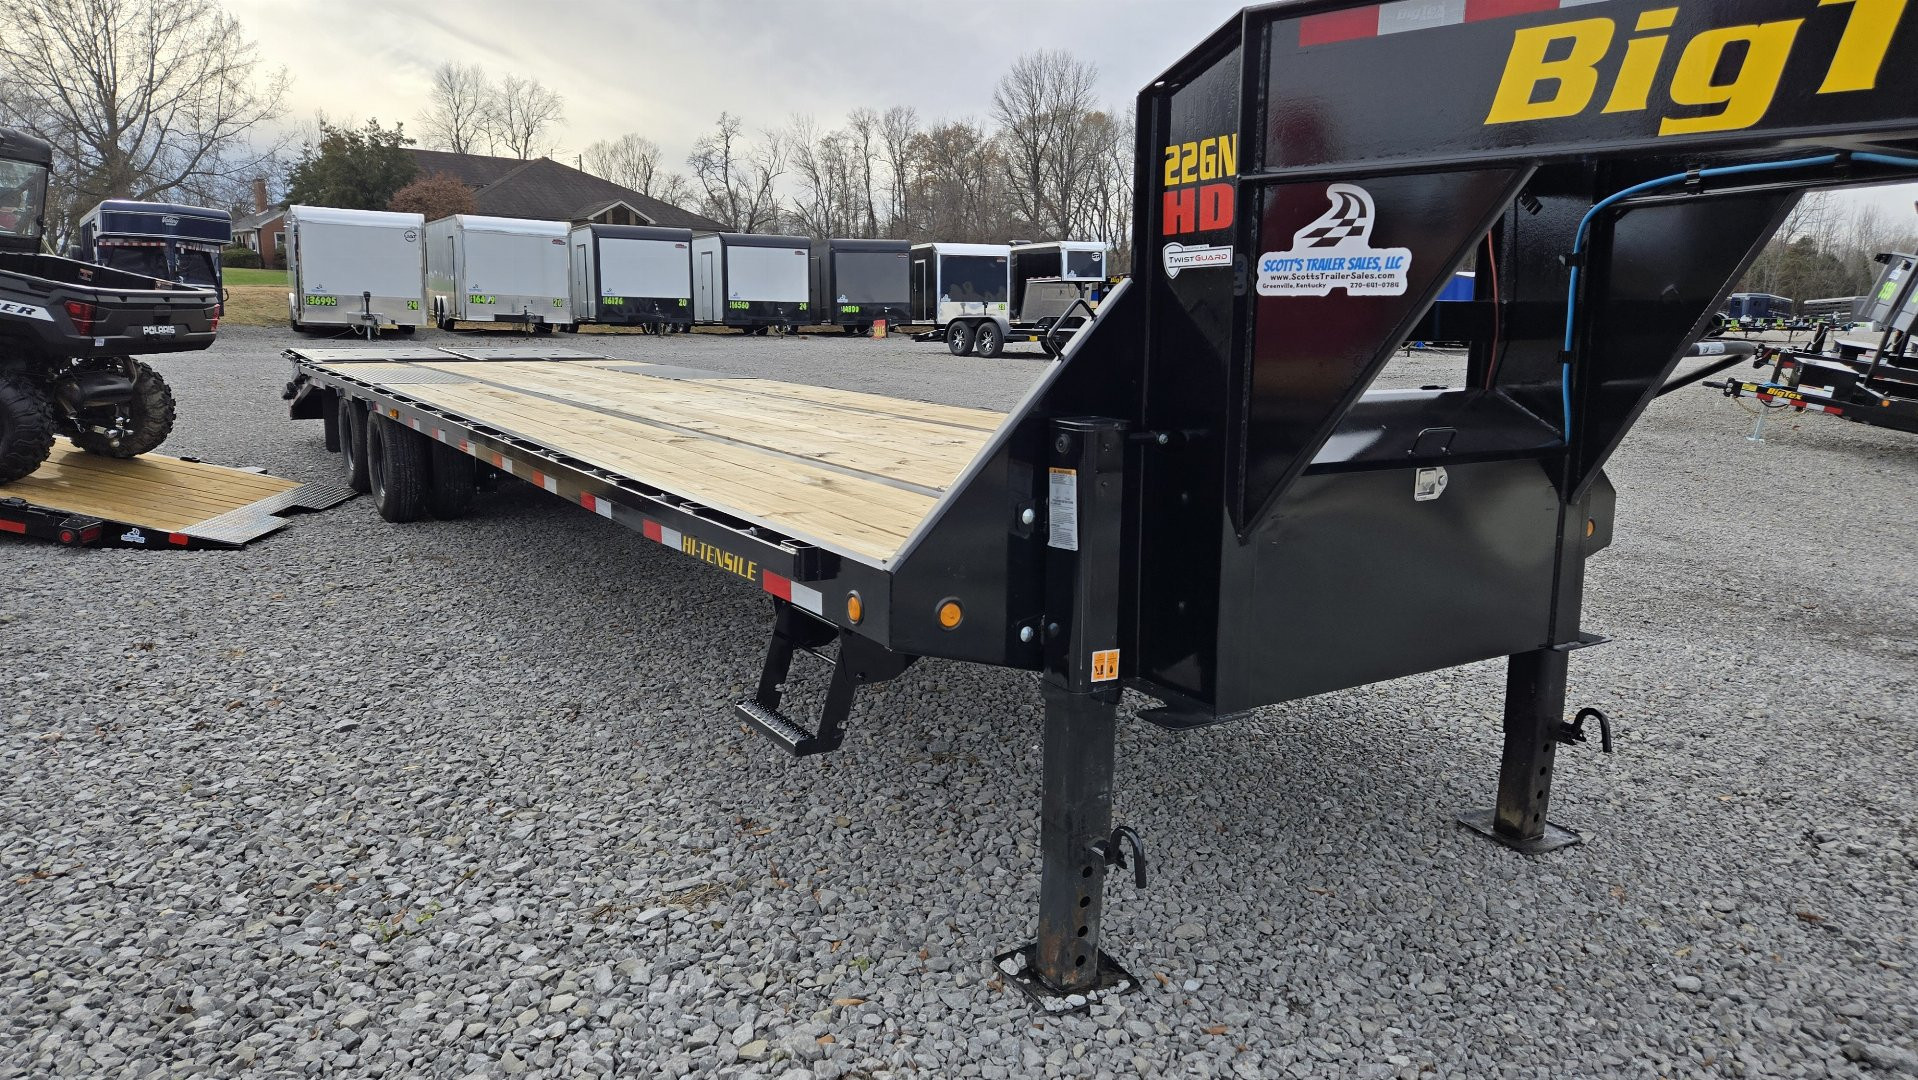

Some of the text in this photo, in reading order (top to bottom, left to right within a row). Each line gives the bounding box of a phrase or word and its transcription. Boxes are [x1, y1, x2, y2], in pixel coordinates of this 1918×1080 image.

[1164, 133, 1237, 186] 22GN
[1163, 183, 1234, 235] HD
[1263, 255, 1403, 272] SCOTT'S TRAILER SALES, LLC
[1270, 272, 1395, 281] www.ScottsTrailerSales.com
[1296, 281, 1327, 289] Kentucky
[553, 299, 563, 307] 20
[678, 298, 688, 307] 20
[0, 303, 37, 315] ER
[142, 325, 176, 335] POLARIS
[1766, 387, 1803, 400] BigTex
[682, 535, 758, 581] HI-TENSILE
